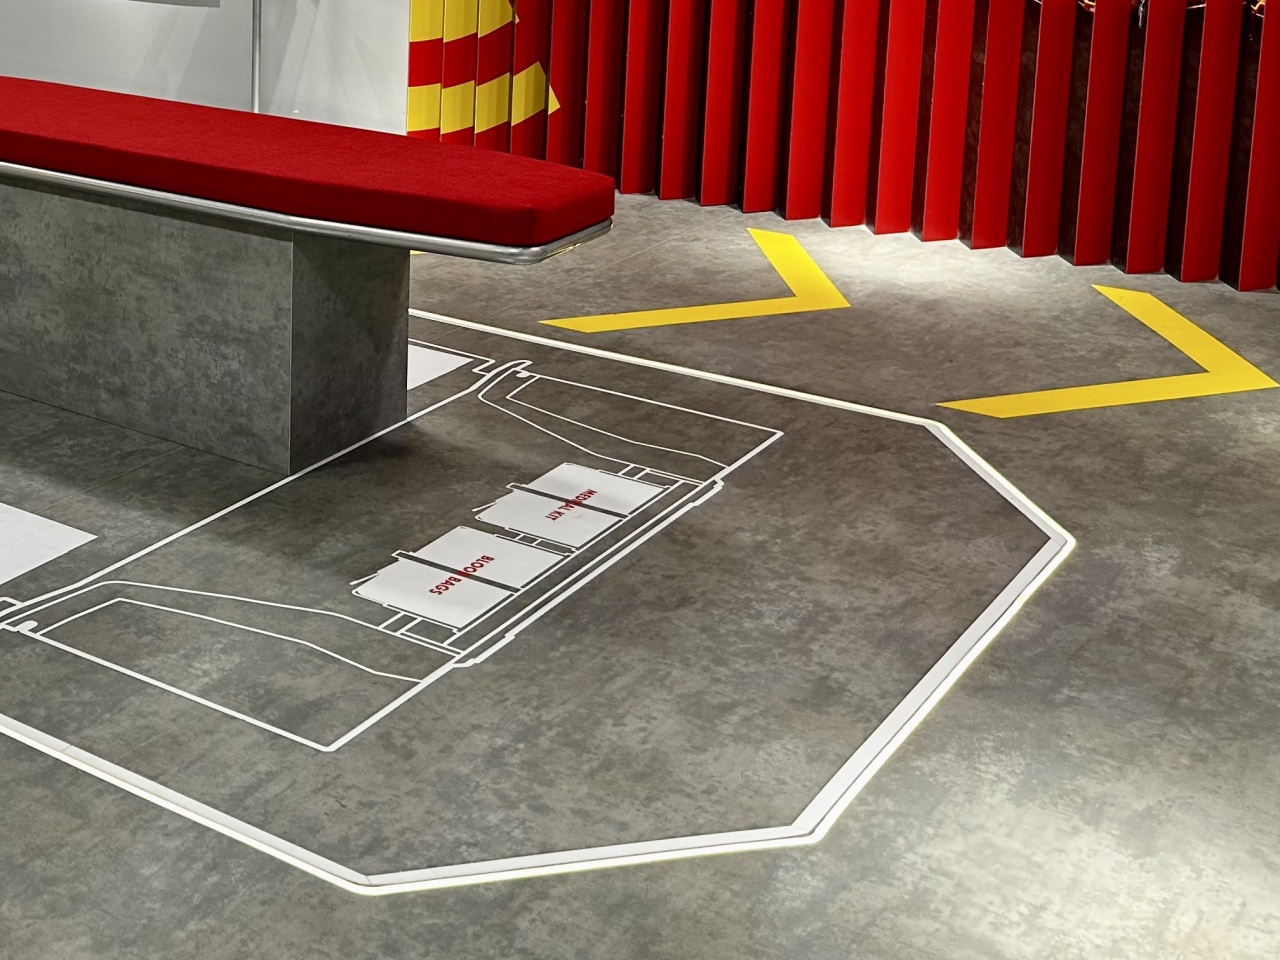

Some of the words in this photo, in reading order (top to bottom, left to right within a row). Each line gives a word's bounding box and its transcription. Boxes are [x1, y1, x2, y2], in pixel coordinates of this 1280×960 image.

[558, 488, 598, 511] MEDAL
[544, 509, 565, 521] KIT
[429, 576, 462, 596] BAGS
